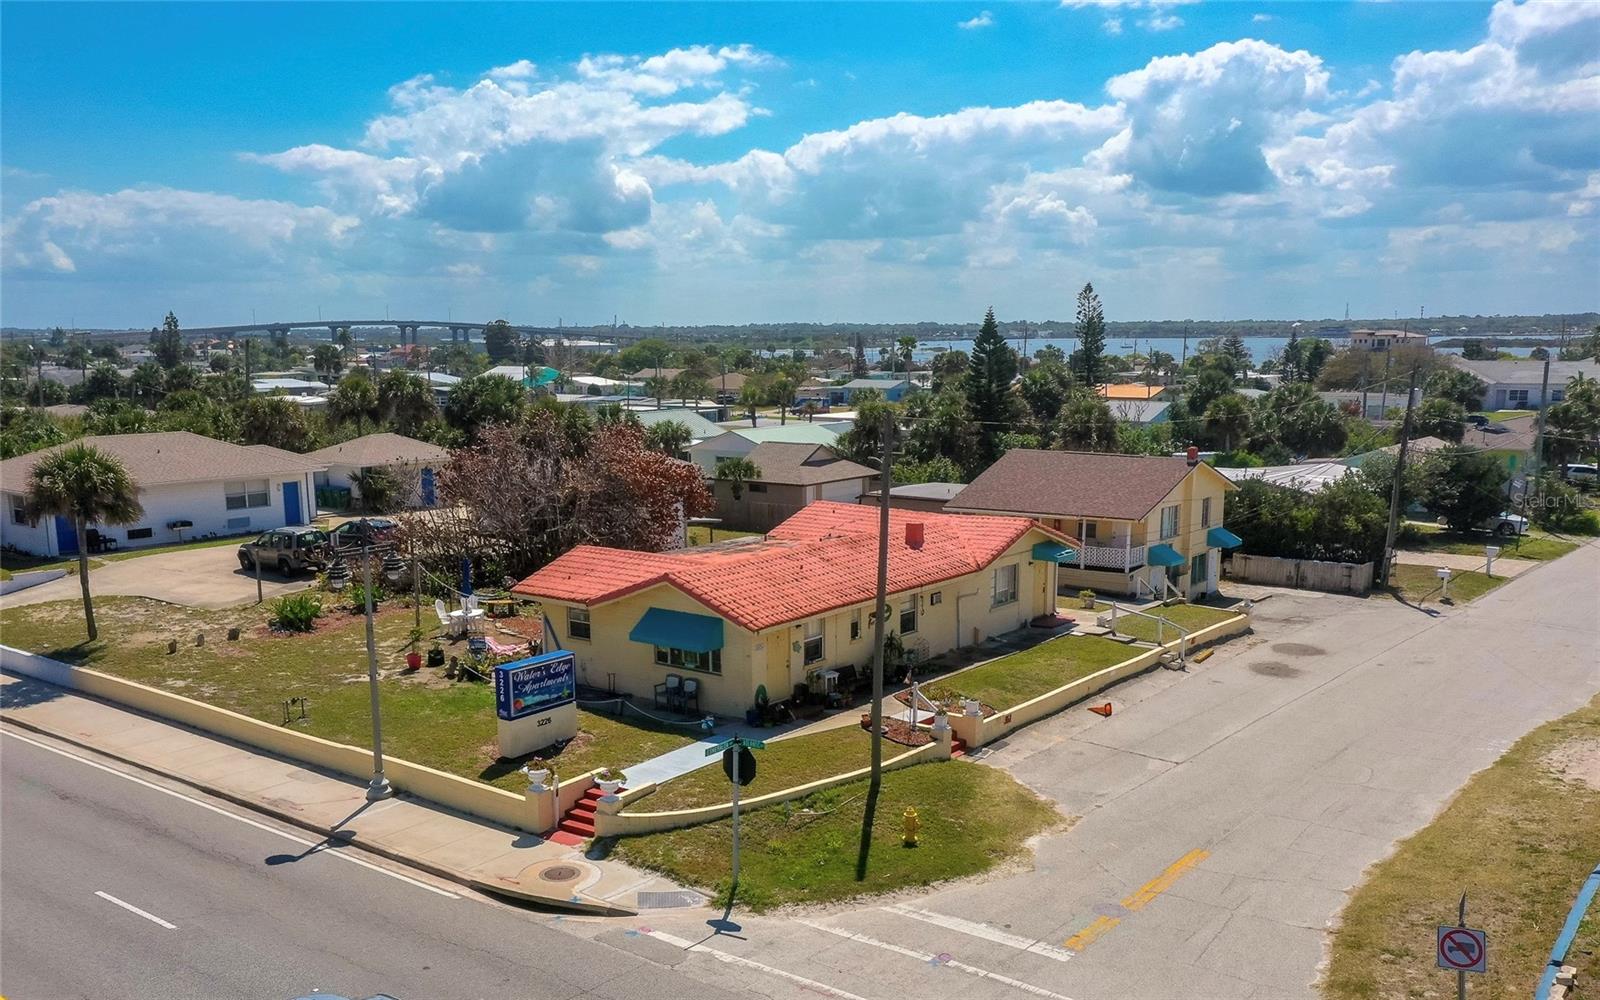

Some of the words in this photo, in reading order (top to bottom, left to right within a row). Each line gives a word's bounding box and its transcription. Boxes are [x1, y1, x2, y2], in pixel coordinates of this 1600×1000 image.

[514, 667, 546, 682] Water's
[550, 662, 570, 673] Edge
[518, 673, 569, 693] Apartments
[537, 717, 552, 727] 3226
